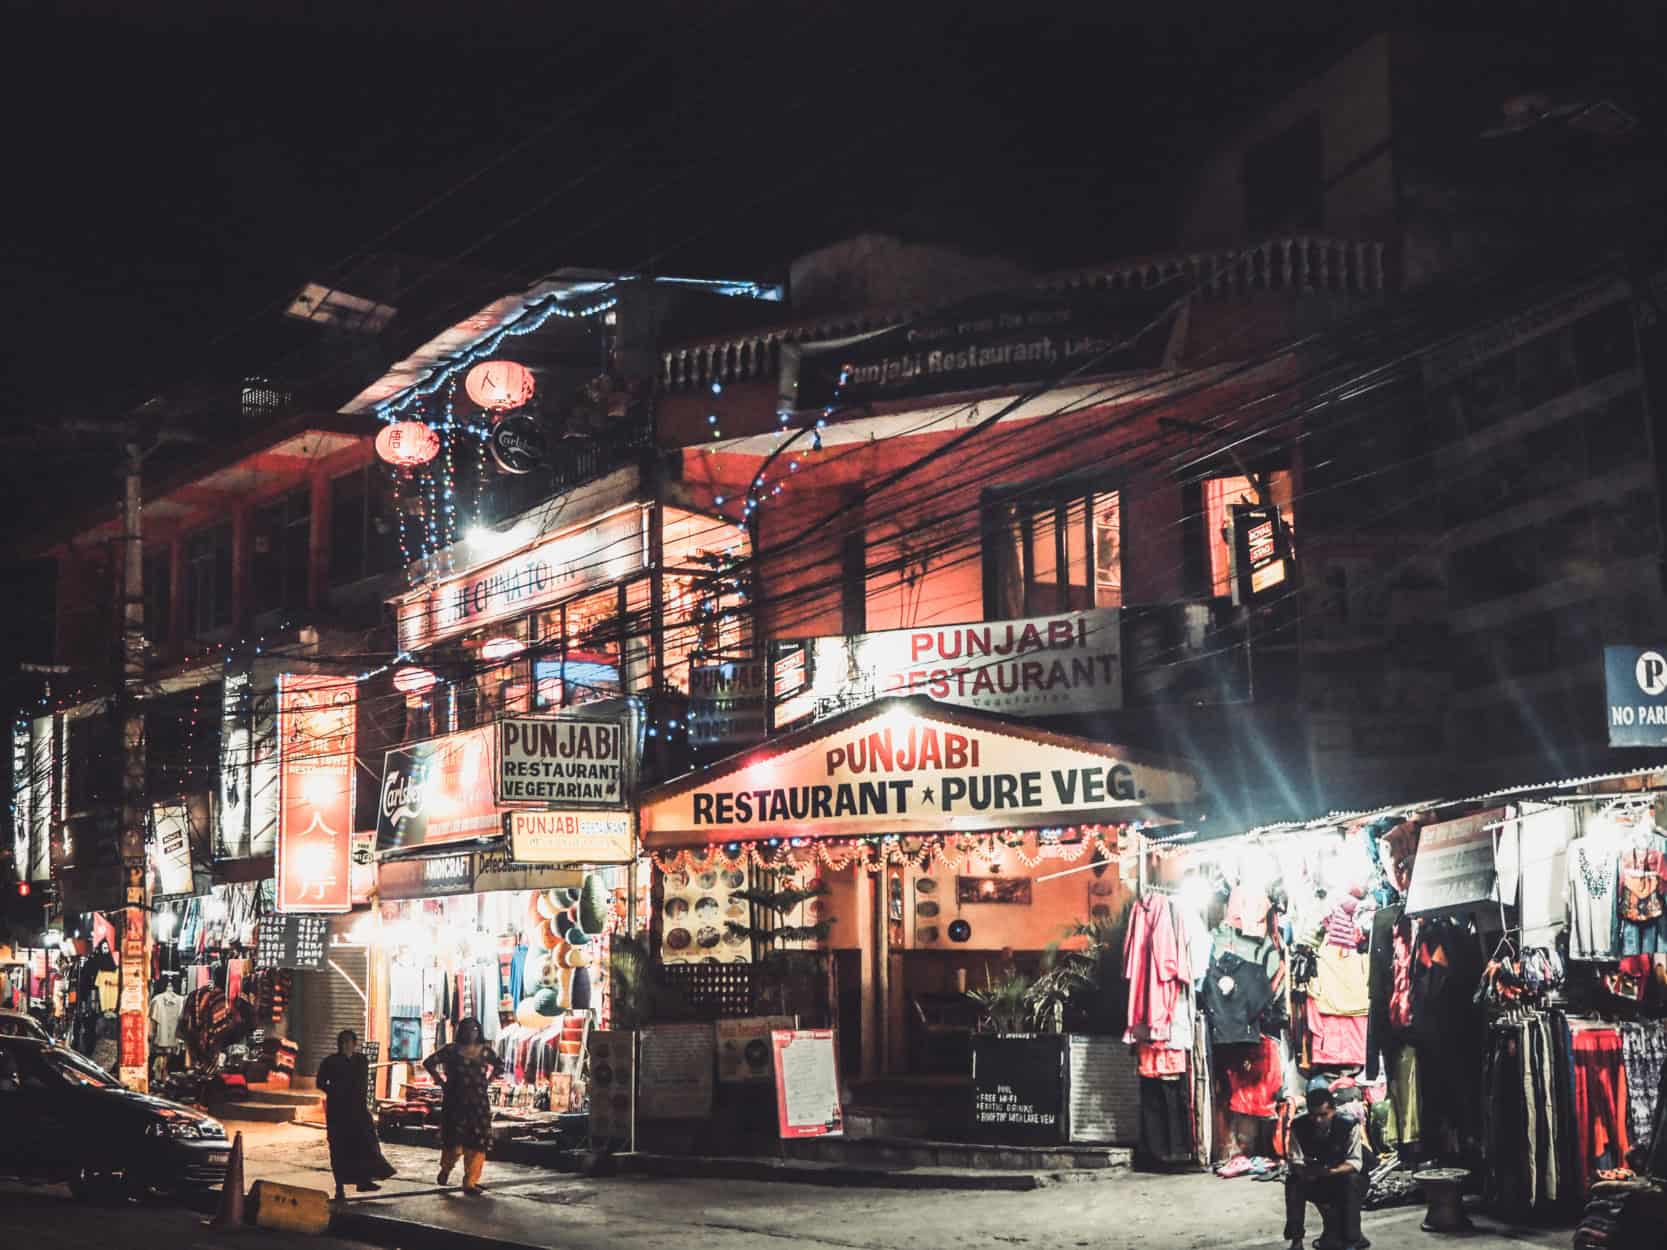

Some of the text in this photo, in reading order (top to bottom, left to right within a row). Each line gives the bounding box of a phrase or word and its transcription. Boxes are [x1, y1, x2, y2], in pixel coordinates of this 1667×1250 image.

[843, 352, 922, 386] Punjabi
[928, 336, 1057, 374] Restaurant,
[525, 559, 577, 594] TON
[910, 618, 1087, 662] PUNJABI
[1611, 704, 1667, 726] NO PAR
[503, 721, 619, 761] PUNJABI
[826, 727, 980, 777] PUNJABI
[504, 761, 620, 781] RESTAURANT
[504, 780, 603, 799] VEGETARIAN
[692, 763, 1147, 825] RESTAURANT PURE VEG.
[516, 815, 579, 835] PUNJABI
[424, 855, 470, 880] ANDICRAFT
